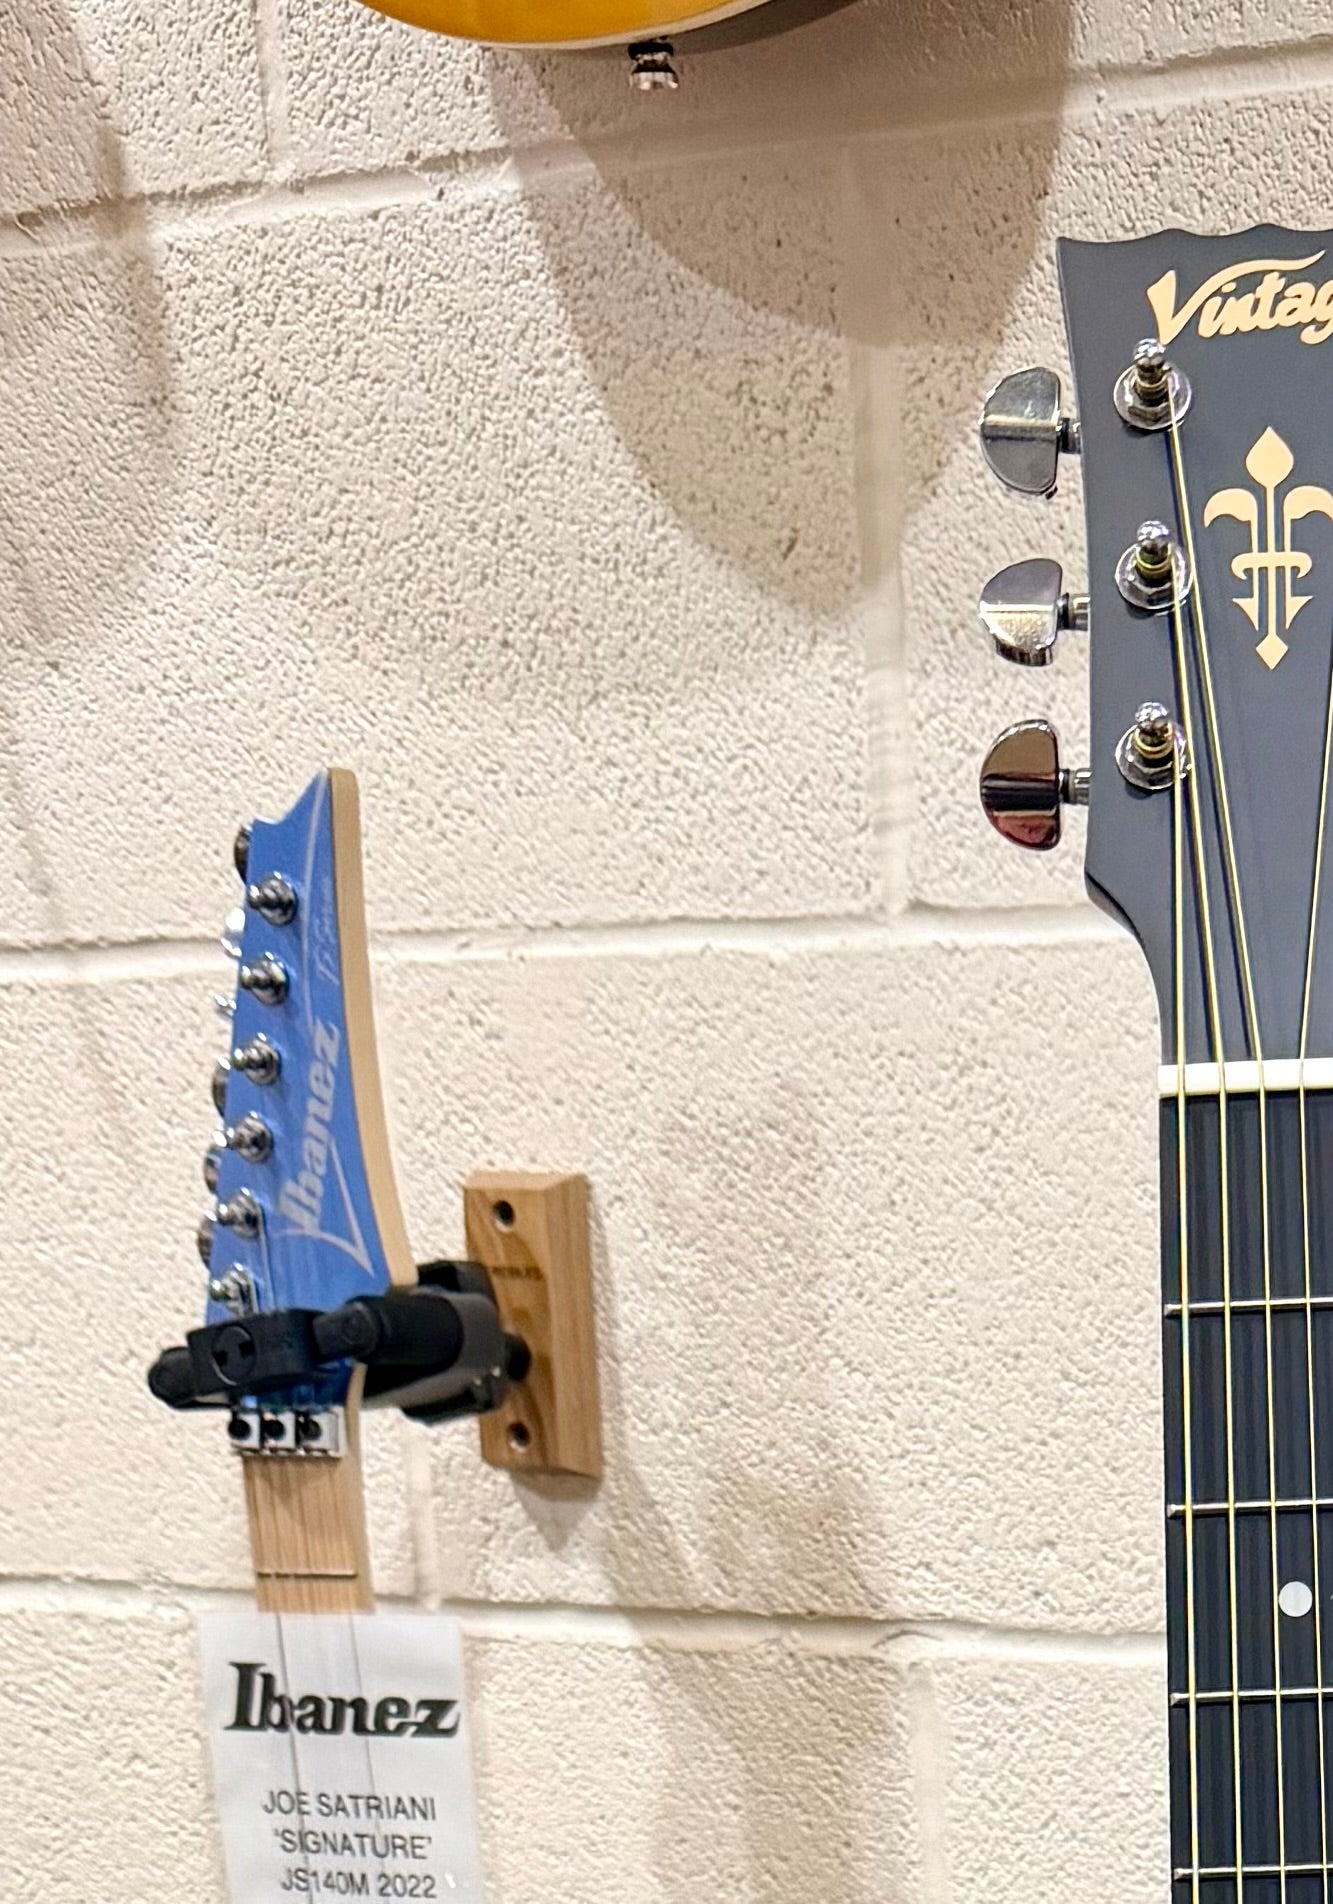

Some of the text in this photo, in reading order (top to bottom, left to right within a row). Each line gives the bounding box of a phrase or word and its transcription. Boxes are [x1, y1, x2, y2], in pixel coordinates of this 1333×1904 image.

[278, 1021, 340, 1234] Ibanez
[224, 1660, 461, 1738] Ibanez
[263, 1790, 437, 1822] JOE SATRIANI
[281, 1869, 437, 1899] JS140M 2022
